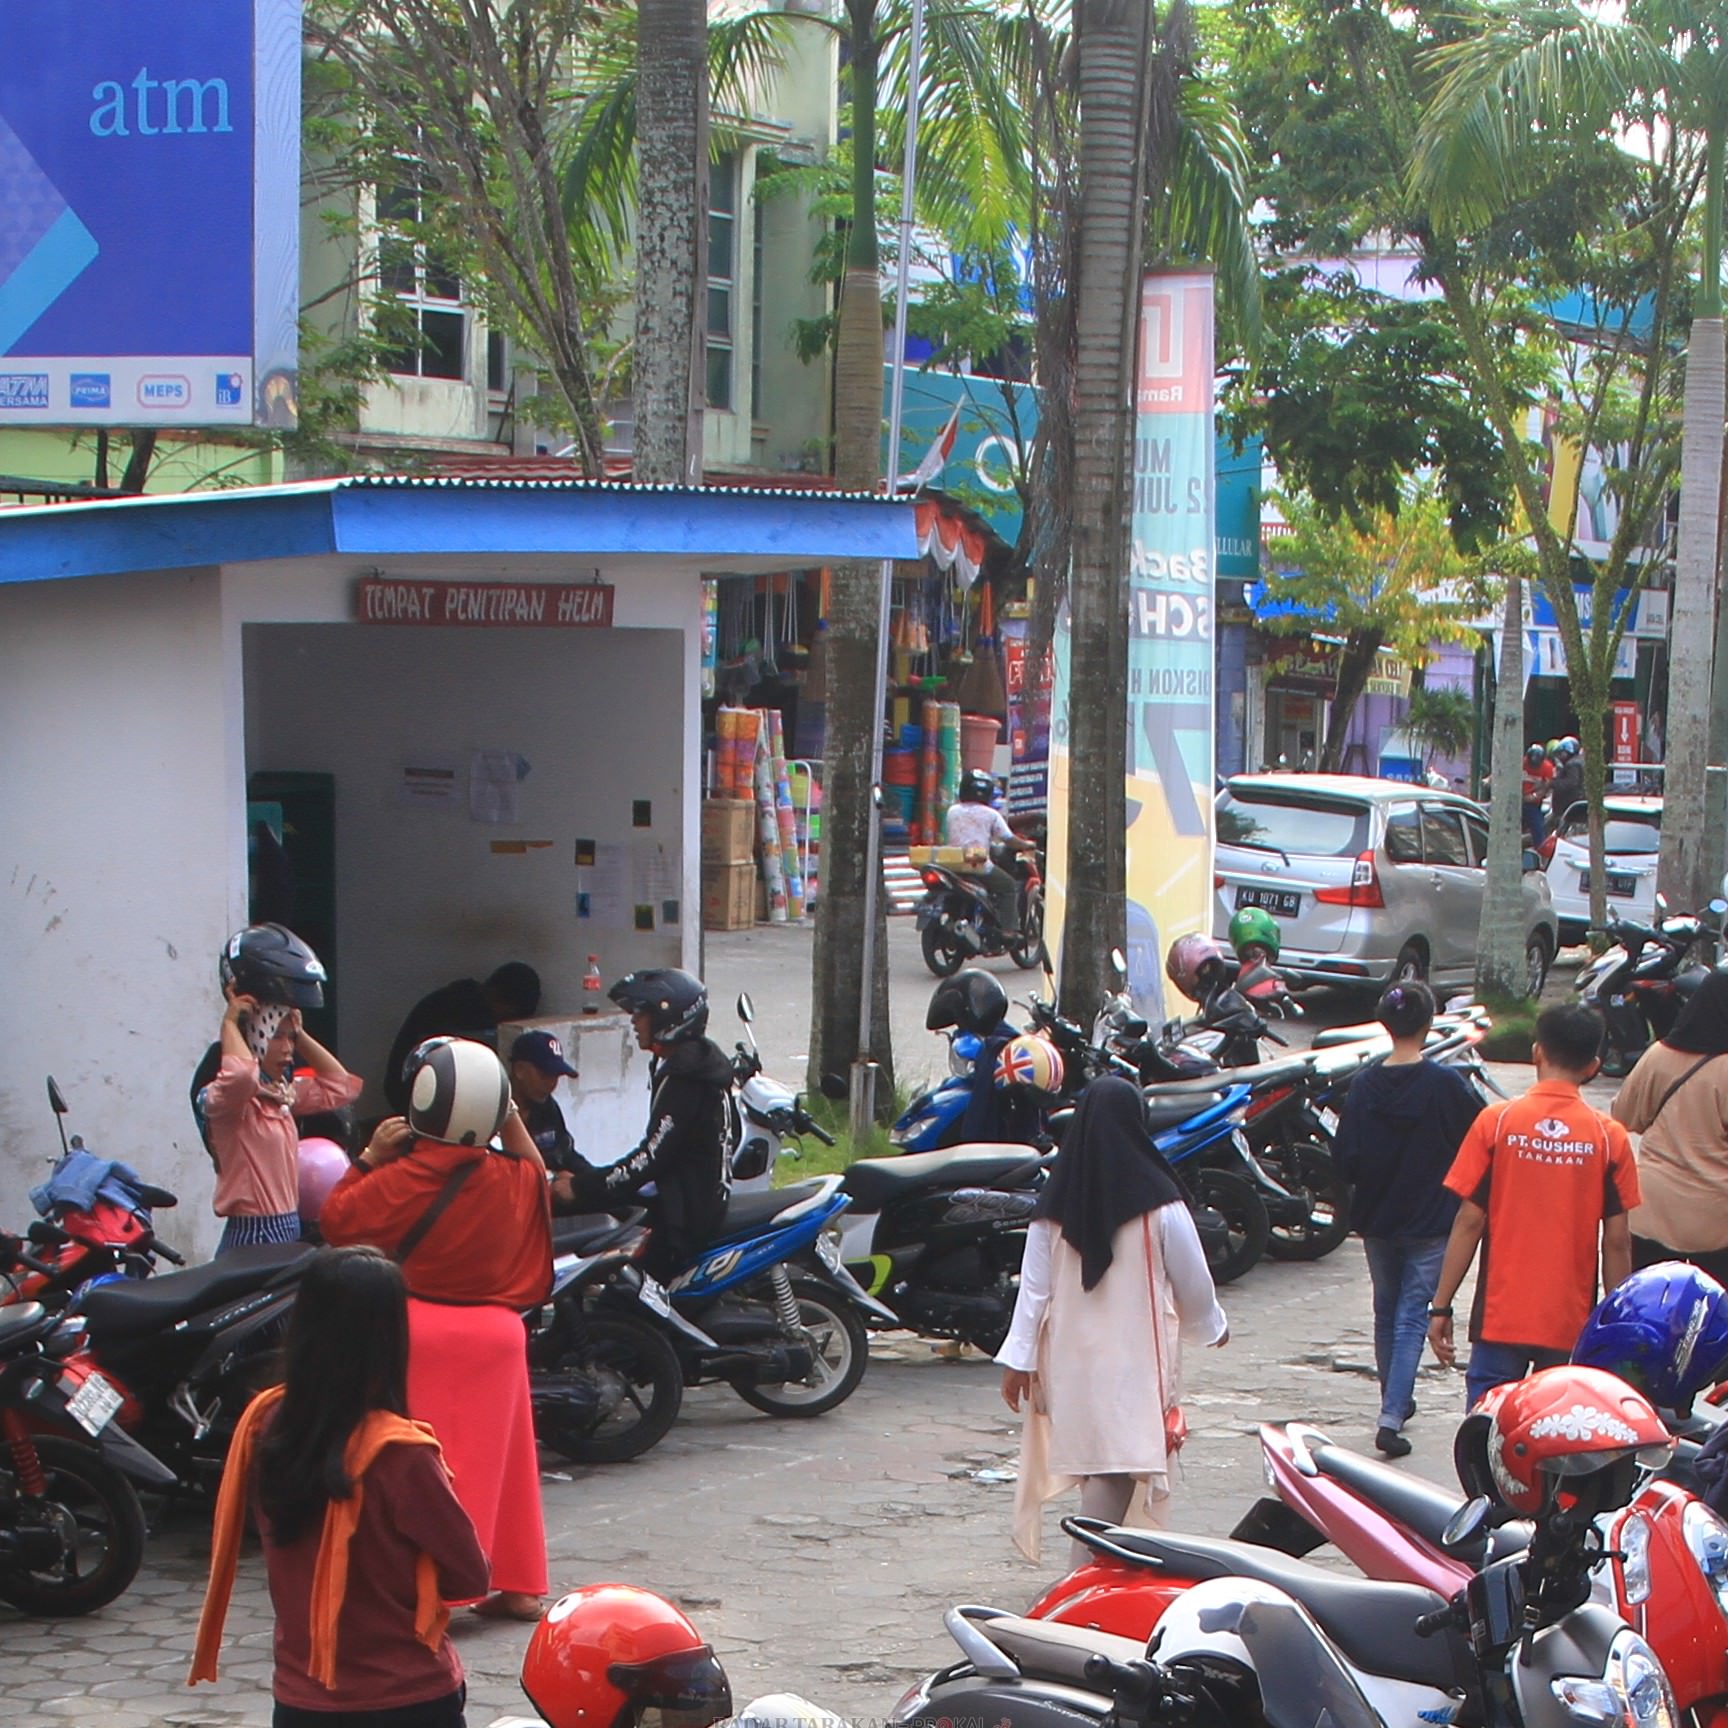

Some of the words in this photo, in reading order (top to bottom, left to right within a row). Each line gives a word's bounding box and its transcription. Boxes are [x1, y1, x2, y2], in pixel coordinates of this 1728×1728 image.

[89, 67, 233, 136] atm
[145, 383, 182, 397] MEPS
[365, 585, 432, 619] TEMPAT
[445, 587, 545, 620] PENITIPAN
[558, 590, 605, 620] HELM
[1507, 1134, 1529, 1148] PT.
[1532, 1138, 1595, 1155] GUSHER
[1518, 1151, 1584, 1166] TARAKAN
